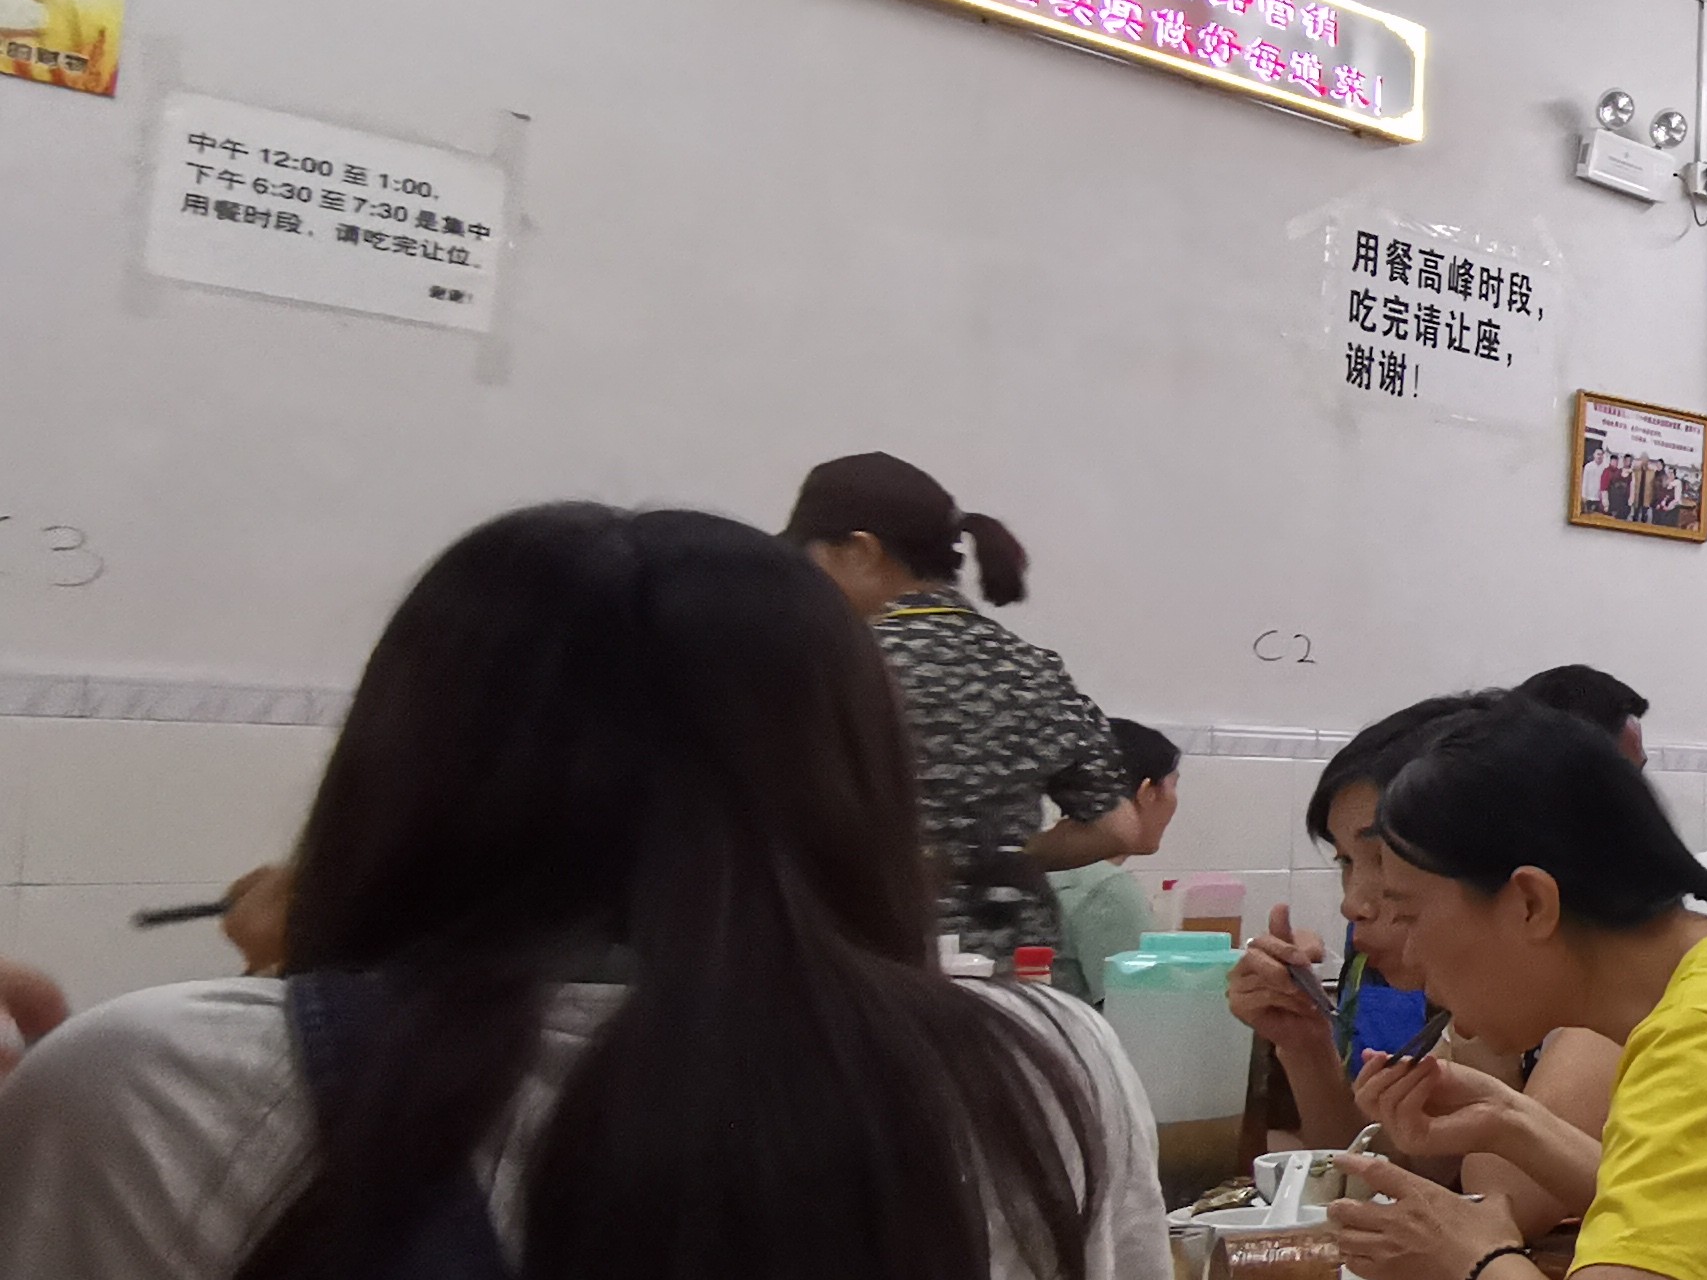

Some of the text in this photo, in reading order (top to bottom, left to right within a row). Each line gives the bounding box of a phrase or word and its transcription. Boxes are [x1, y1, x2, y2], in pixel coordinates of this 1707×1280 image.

[188, 132, 249, 160] 中午
[259, 148, 334, 177] 12:00
[342, 163, 369, 187] 至
[185, 161, 491, 242] 下午 6:30 至 7:30 是集中
[1351, 230, 1543, 322] 用餐高峰时段，
[1348, 287, 1512, 368] 吃完请让座，
[1345, 342, 1420, 398] 谢谢！
[1253, 630, 1316, 664] C2
